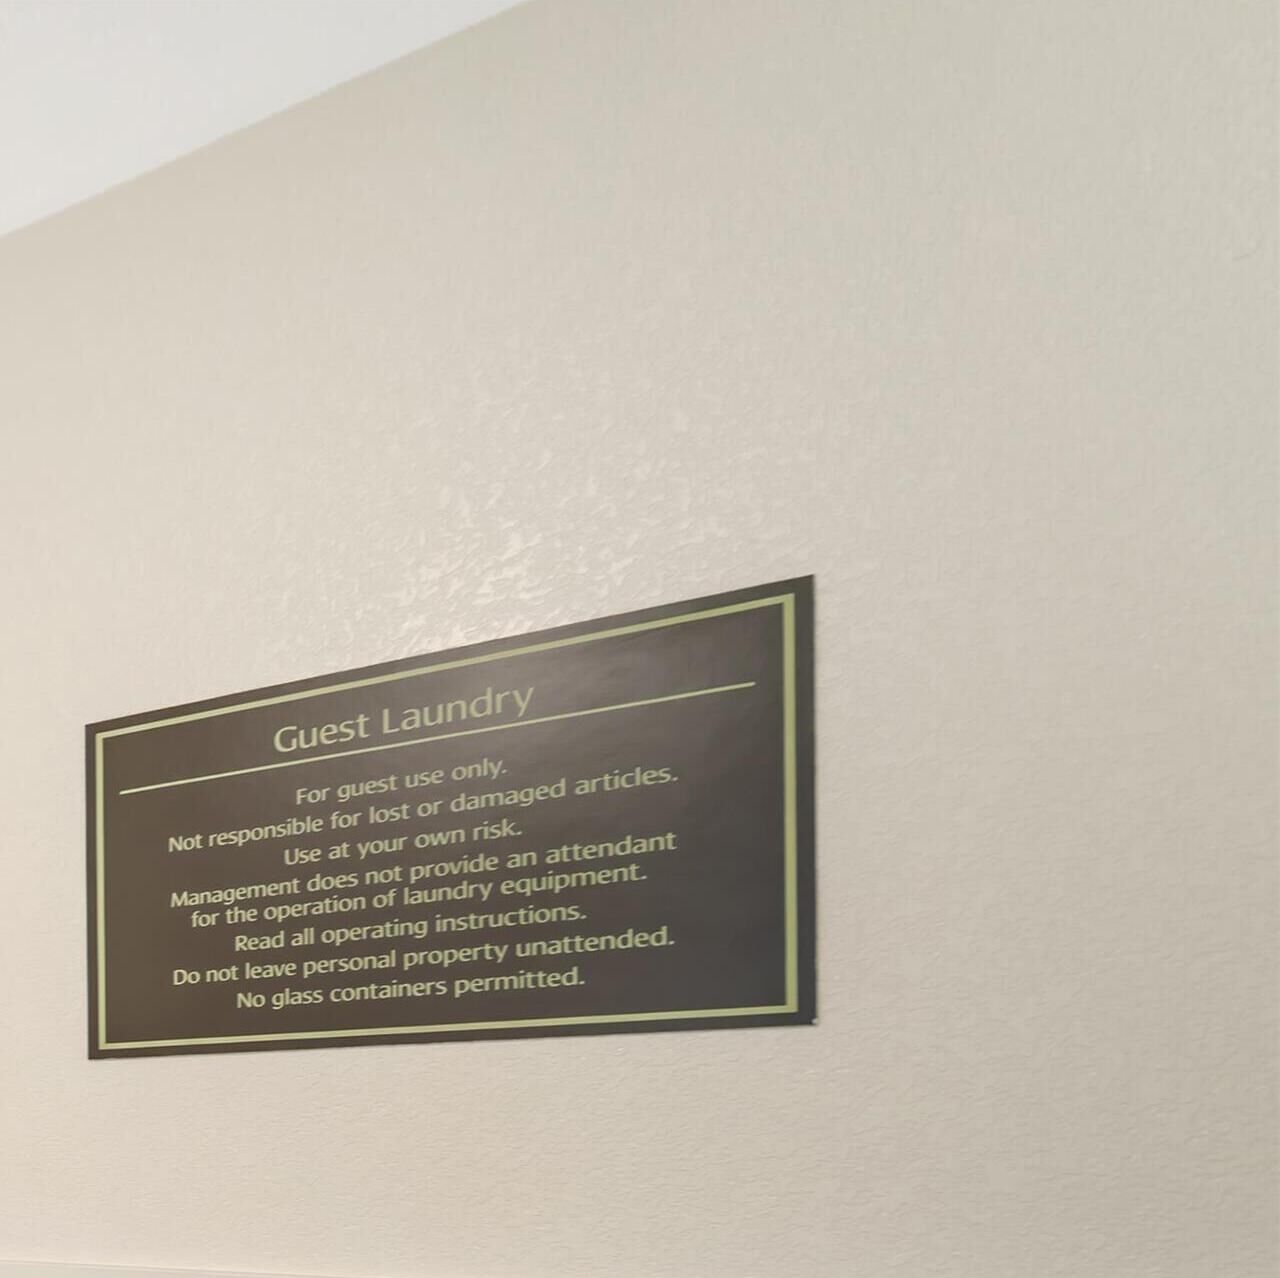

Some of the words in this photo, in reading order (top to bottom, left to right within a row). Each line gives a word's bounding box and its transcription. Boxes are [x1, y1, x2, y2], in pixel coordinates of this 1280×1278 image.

[273, 713, 370, 753] Guest
[382, 687, 534, 734] Laundry
[168, 833, 202, 852] Not
[208, 815, 324, 846] responsible
[330, 811, 362, 830] for
[369, 802, 411, 824] lost
[417, 799, 443, 817] or
[450, 778, 566, 813] damaged
[574, 766, 679, 795] articles.
[295, 786, 331, 805] For
[337, 773, 398, 803] guest
[404, 768, 445, 789] use
[451, 757, 508, 779] only.
[170, 878, 300, 908] Management
[306, 872, 359, 893] does
[365, 864, 403, 885] not
[409, 854, 499, 884] provide
[506, 850, 537, 868] an
[545, 832, 677, 864] attendant
[284, 848, 321, 865] Use
[328, 842, 350, 860] at
[357, 835, 408, 859] your
[414, 829, 465, 849] own
[473, 818, 523, 840] risk.
[191, 910, 220, 928] for
[226, 906, 258, 924] the
[263, 894, 366, 923] operation
[372, 889, 397, 909] of
[403, 880, 494, 905] laundry
[500, 863, 647, 896] equipment.
[172, 969, 201, 985] Do
[206, 964, 239, 983] not
[244, 962, 297, 979] leave
[303, 950, 396, 978] personal
[403, 943, 508, 970] property
[516, 925, 675, 957] unattended.
[234, 931, 285, 952] Read
[291, 927, 314, 947] all
[320, 918, 428, 946] operating
[435, 904, 587, 933] instructions.
[236, 992, 266, 1009] No
[271, 987, 324, 1010] glass
[329, 979, 448, 1002] containers
[454, 966, 586, 998] permitted.
